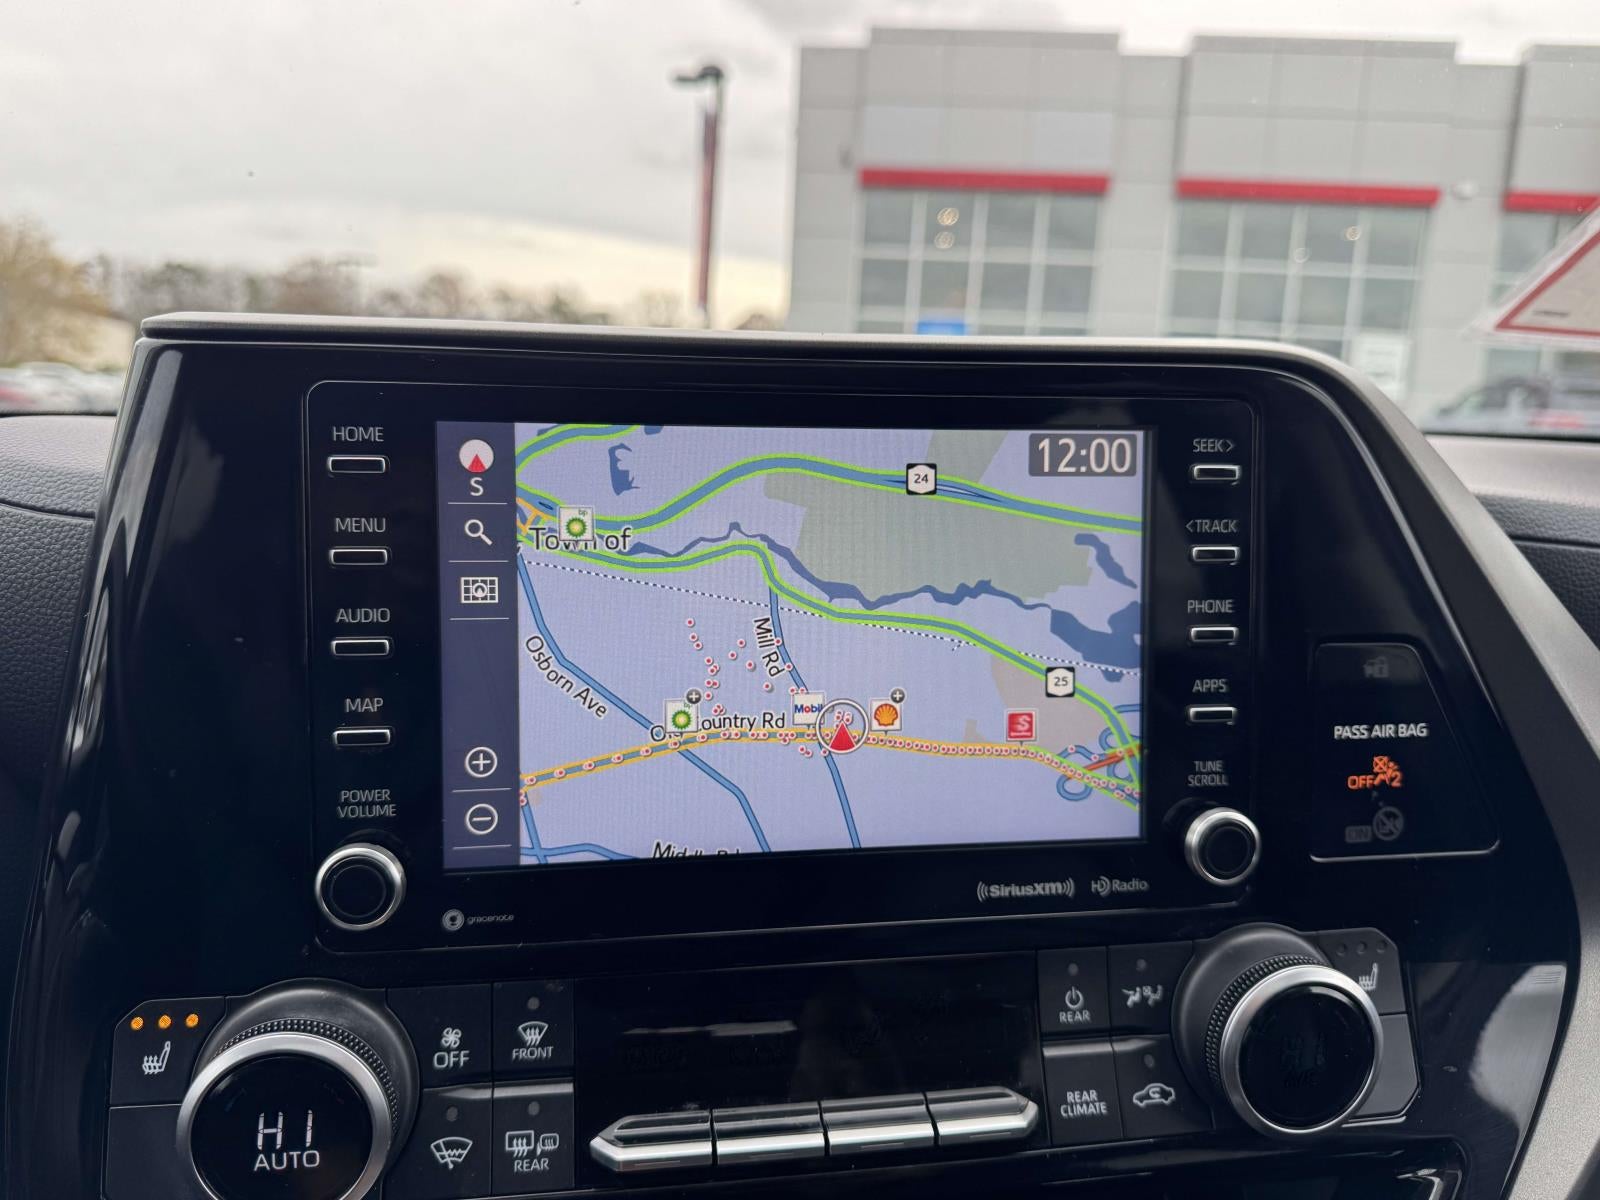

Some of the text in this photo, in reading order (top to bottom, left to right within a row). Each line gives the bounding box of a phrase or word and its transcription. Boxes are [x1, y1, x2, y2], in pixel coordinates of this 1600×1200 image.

[332, 426, 385, 442] HOME
[1038, 438, 1131, 473] 12:00
[469, 476, 484, 496] S
[914, 473, 929, 484] 24
[334, 517, 387, 533] MENU
[605, 527, 632, 551] of
[1187, 599, 1235, 614] PHONE
[335, 607, 391, 623] AUDIO
[753, 616, 787, 678] Mill Rd
[525, 635, 608, 718] Osborn Ave
[1053, 676, 1069, 687] 25
[1191, 678, 1228, 693] APPS
[344, 697, 385, 713] MAP
[794, 703, 824, 714] Mobil
[700, 712, 786, 732] ountry Rd
[1333, 722, 1428, 739] PASS AIR BAG
[1194, 760, 1224, 773] TUNE
[1187, 774, 1229, 787] SCROLL
[1347, 775, 1374, 790] OFF
[341, 788, 391, 803] POWER
[337, 804, 397, 818] VOLUME
[1112, 878, 1149, 892] Radio
[467, 913, 515, 925] gracenote
[1059, 1010, 1091, 1024] REAR
[433, 1050, 470, 1069] OFF
[512, 1046, 555, 1062] FRONT
[1066, 1089, 1099, 1104] REAR
[1060, 1102, 1108, 1118] CLIMATE
[253, 1150, 321, 1172] AUTO
[514, 1157, 550, 1173] REAR
